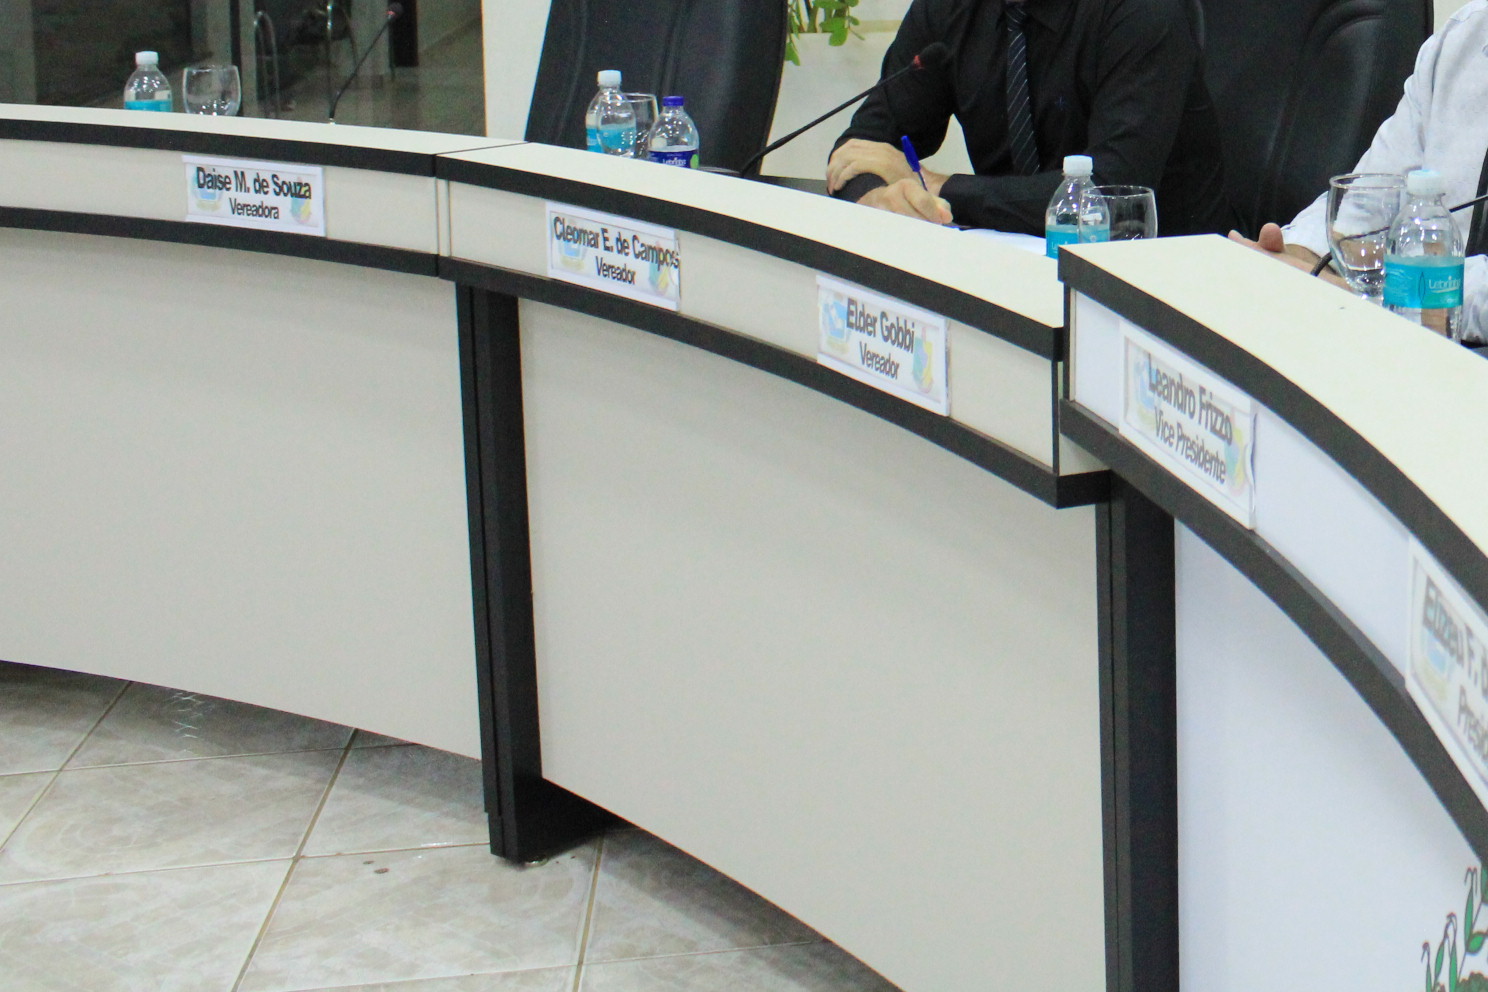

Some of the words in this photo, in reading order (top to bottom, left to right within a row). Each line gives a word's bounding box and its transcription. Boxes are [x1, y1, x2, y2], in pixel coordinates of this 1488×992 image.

[196, 166, 232, 191] Daise
[233, 170, 250, 194] M.
[253, 172, 270, 195] de
[271, 174, 312, 200] Souza
[228, 197, 280, 220] Vereadora
[553, 216, 600, 249] Cleomar
[601, 227, 614, 252] E.
[615, 231, 630, 256] de
[631, 234, 680, 272] Campos
[595, 255, 637, 285] Vereador
[846, 297, 878, 338] Elder
[879, 311, 915, 354] Gobbi
[859, 341, 900, 380] Vereador
[1148, 358, 1196, 419] Leandro
[1199, 385, 1233, 446] Frizzo
[1154, 406, 1175, 448] Vice
[1176, 421, 1226, 484] Presidente
